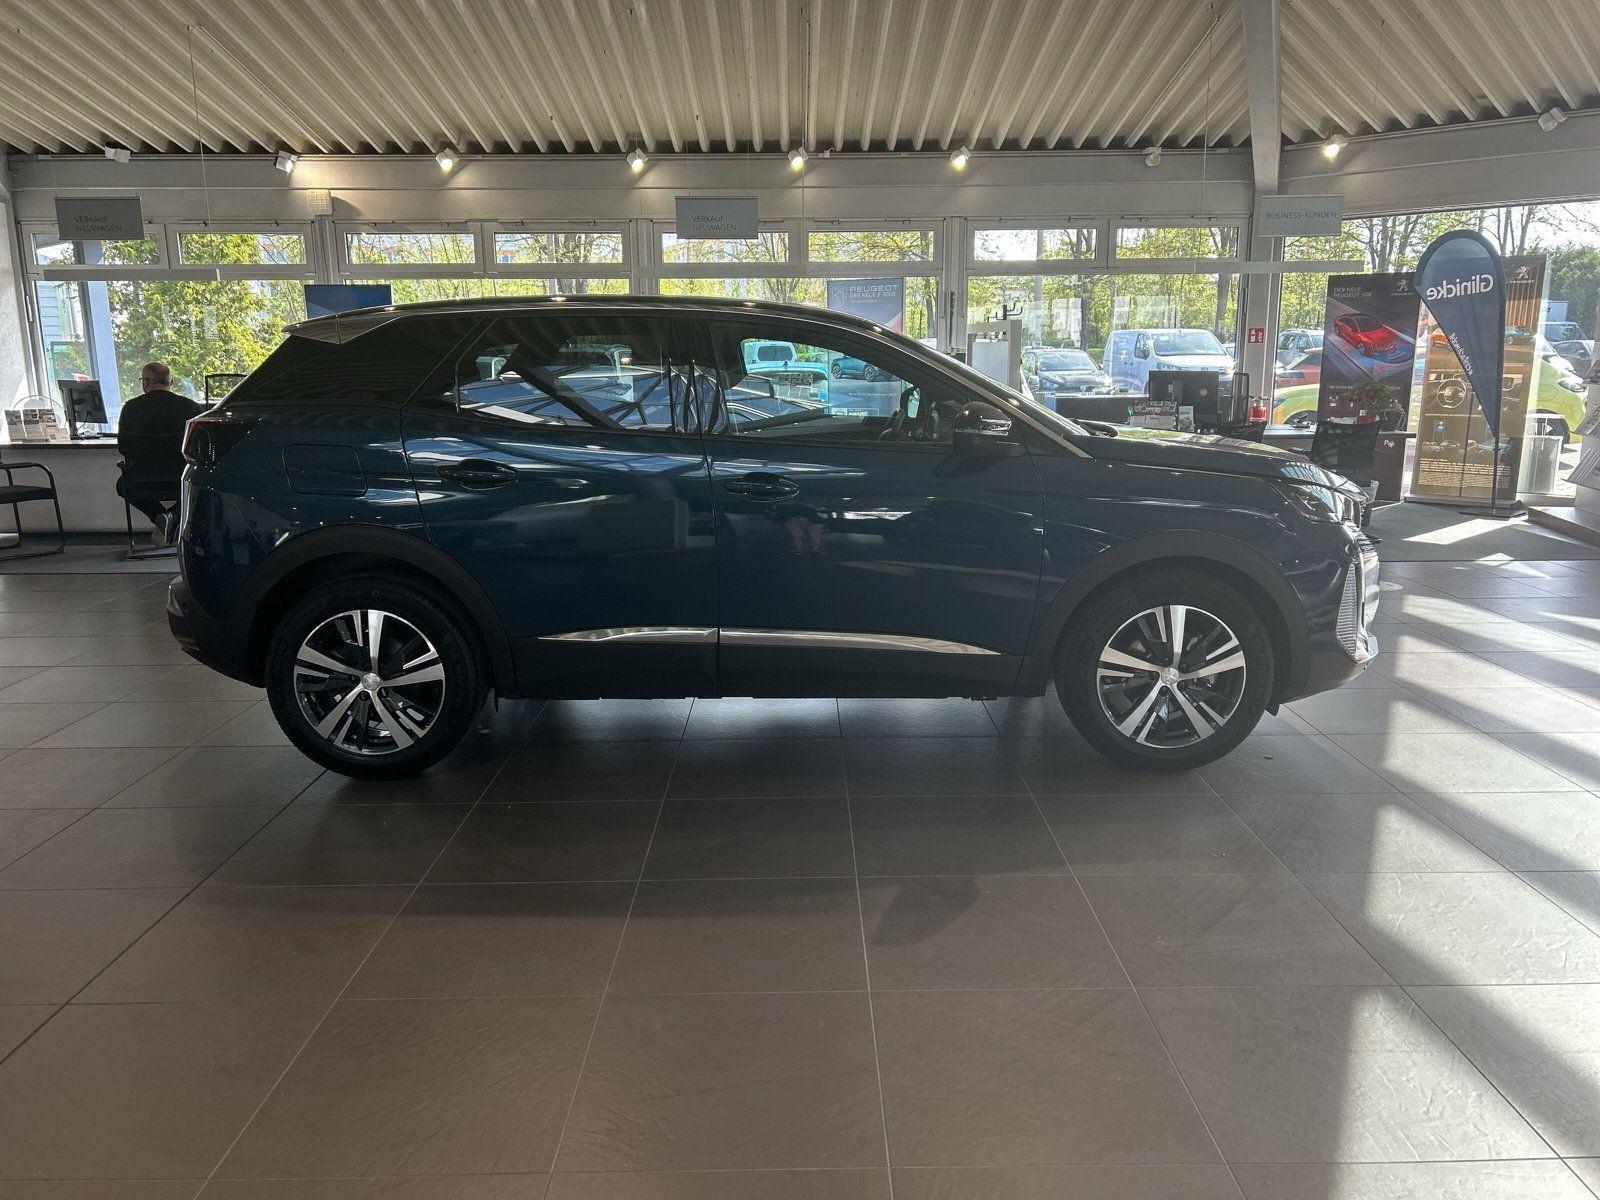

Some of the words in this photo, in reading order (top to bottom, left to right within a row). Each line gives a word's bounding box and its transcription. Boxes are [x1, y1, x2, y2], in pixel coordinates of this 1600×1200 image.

[73, 215, 109, 223] VERKAUF
[692, 215, 724, 223] VERKAUF
[1266, 211, 1337, 220] BUSINESS-KUNDEN
[74, 224, 122, 232] NEUWAGEN
[692, 224, 737, 232] NEUWAGEN
